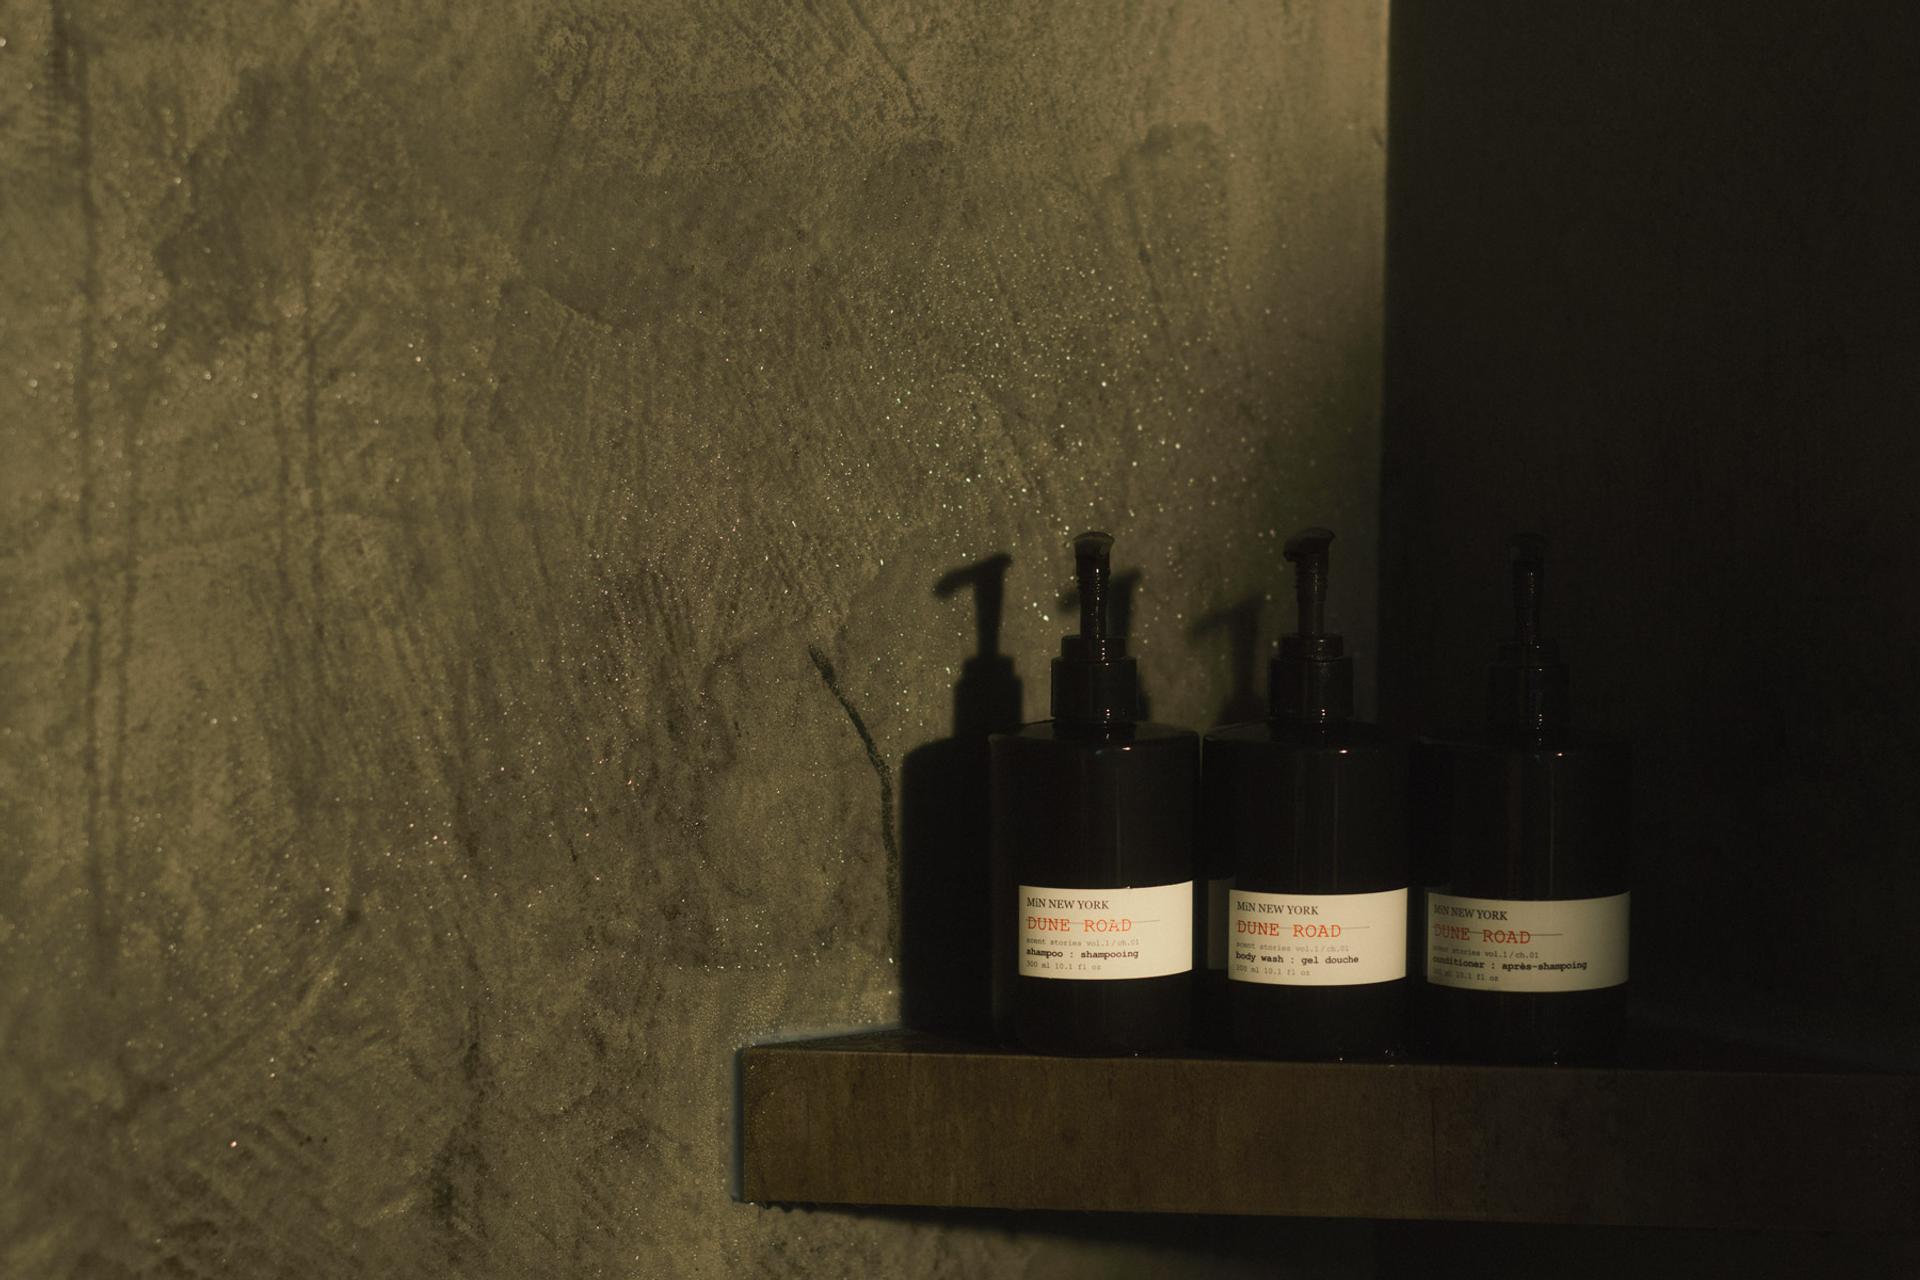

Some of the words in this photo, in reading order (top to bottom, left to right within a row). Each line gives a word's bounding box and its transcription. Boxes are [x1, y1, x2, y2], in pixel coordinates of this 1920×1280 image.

[1049, 899, 1074, 909] NEW
[1078, 900, 1110, 910] YORK
[1258, 903, 1284, 914] NEW
[1287, 905, 1319, 916] YORK
[1451, 907, 1474, 918] NEW
[1476, 910, 1508, 920] YORK
[1027, 916, 1070, 932] DUNE
[1084, 919, 1132, 932] ROAD
[1237, 920, 1280, 936] DUNE
[1293, 924, 1342, 938] ROAD
[1434, 924, 1470, 940] DUNE
[1482, 929, 1530, 944] ROAD
[1026, 948, 1064, 959] shampoo
[1080, 950, 1139, 960] shampooing
[1236, 952, 1256, 962] body
[1261, 955, 1284, 963] wash
[1301, 956, 1318, 966] gel
[1325, 955, 1359, 964] douche
[1055, 962, 1072, 970] 10.1
[1502, 961, 1588, 972] après-shampoing
